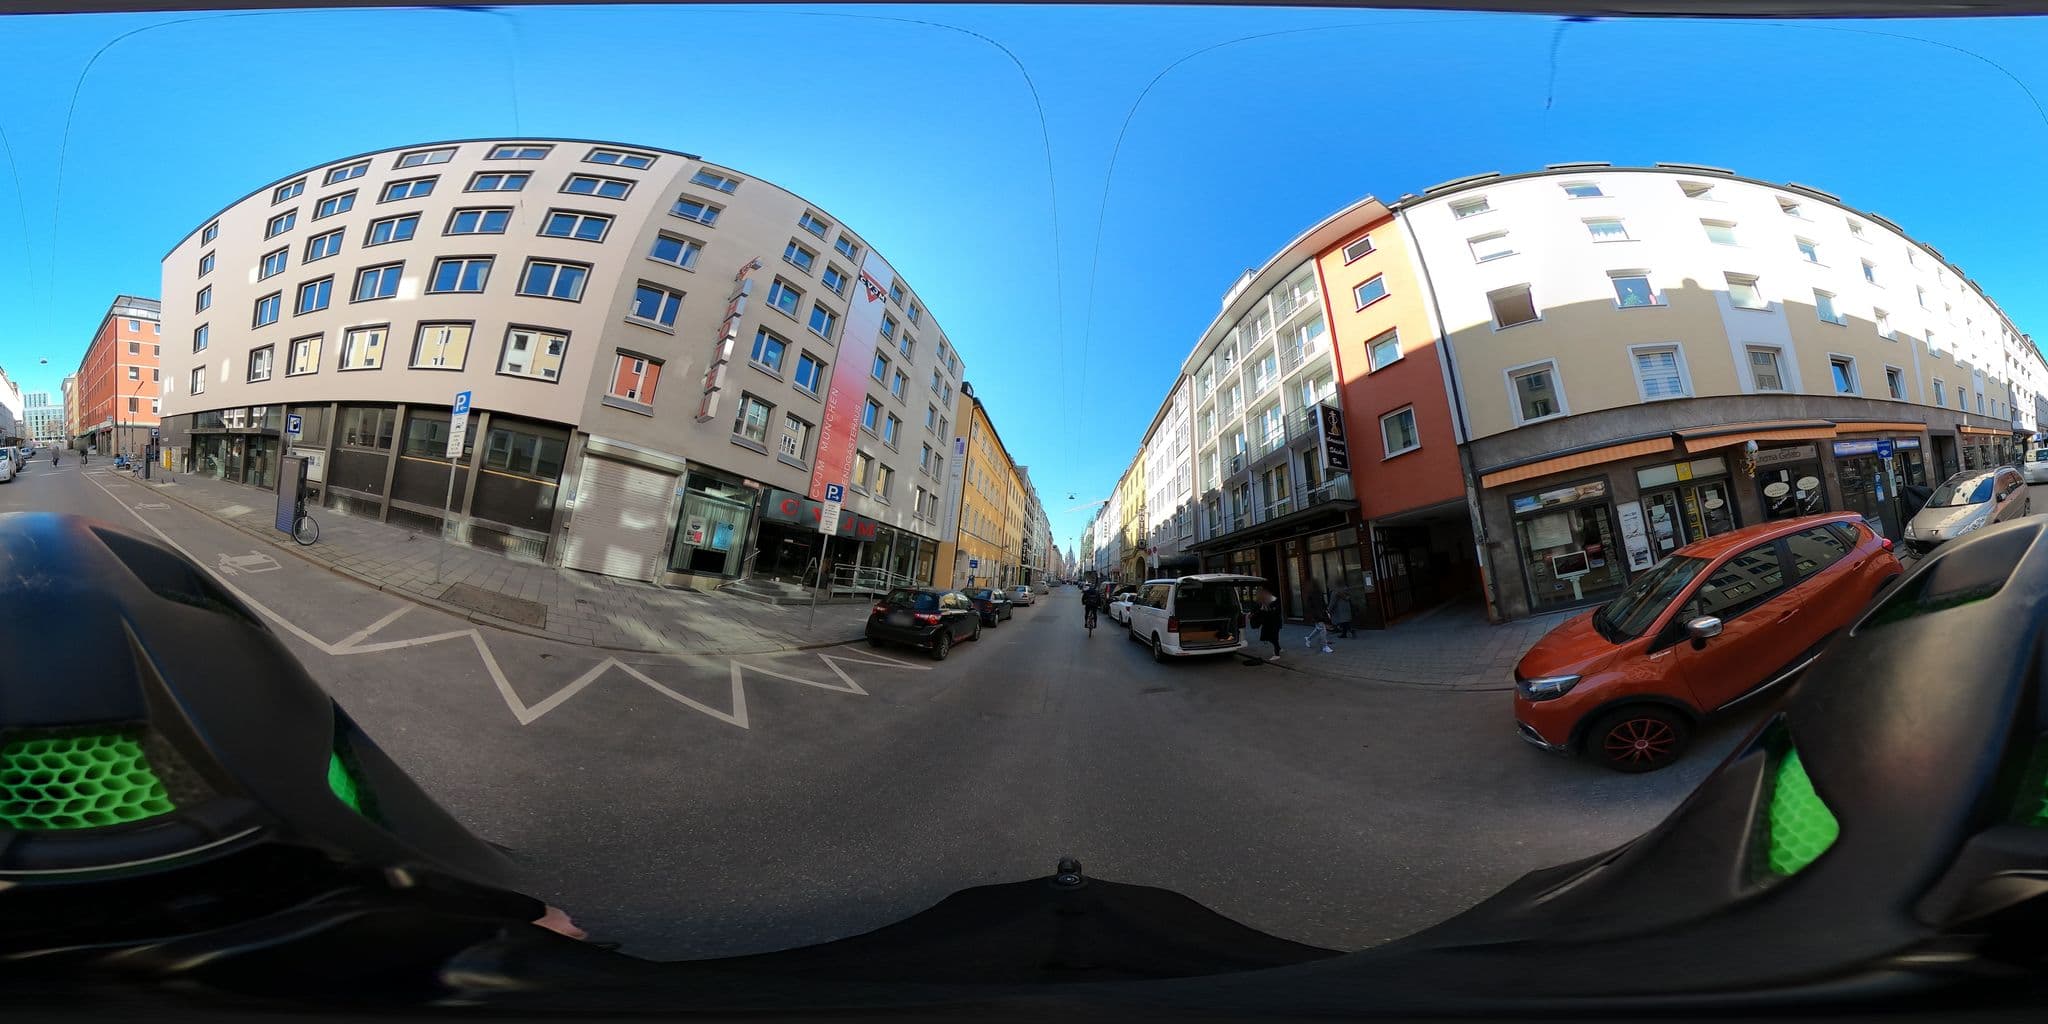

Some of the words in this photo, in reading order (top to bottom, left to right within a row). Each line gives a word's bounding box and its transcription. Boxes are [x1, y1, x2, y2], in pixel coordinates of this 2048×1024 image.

[700, 300, 737, 417] HOTEL
[1779, 449, 1801, 459] Gelato
[812, 459, 826, 498] CVJM
[827, 485, 839, 499] P
